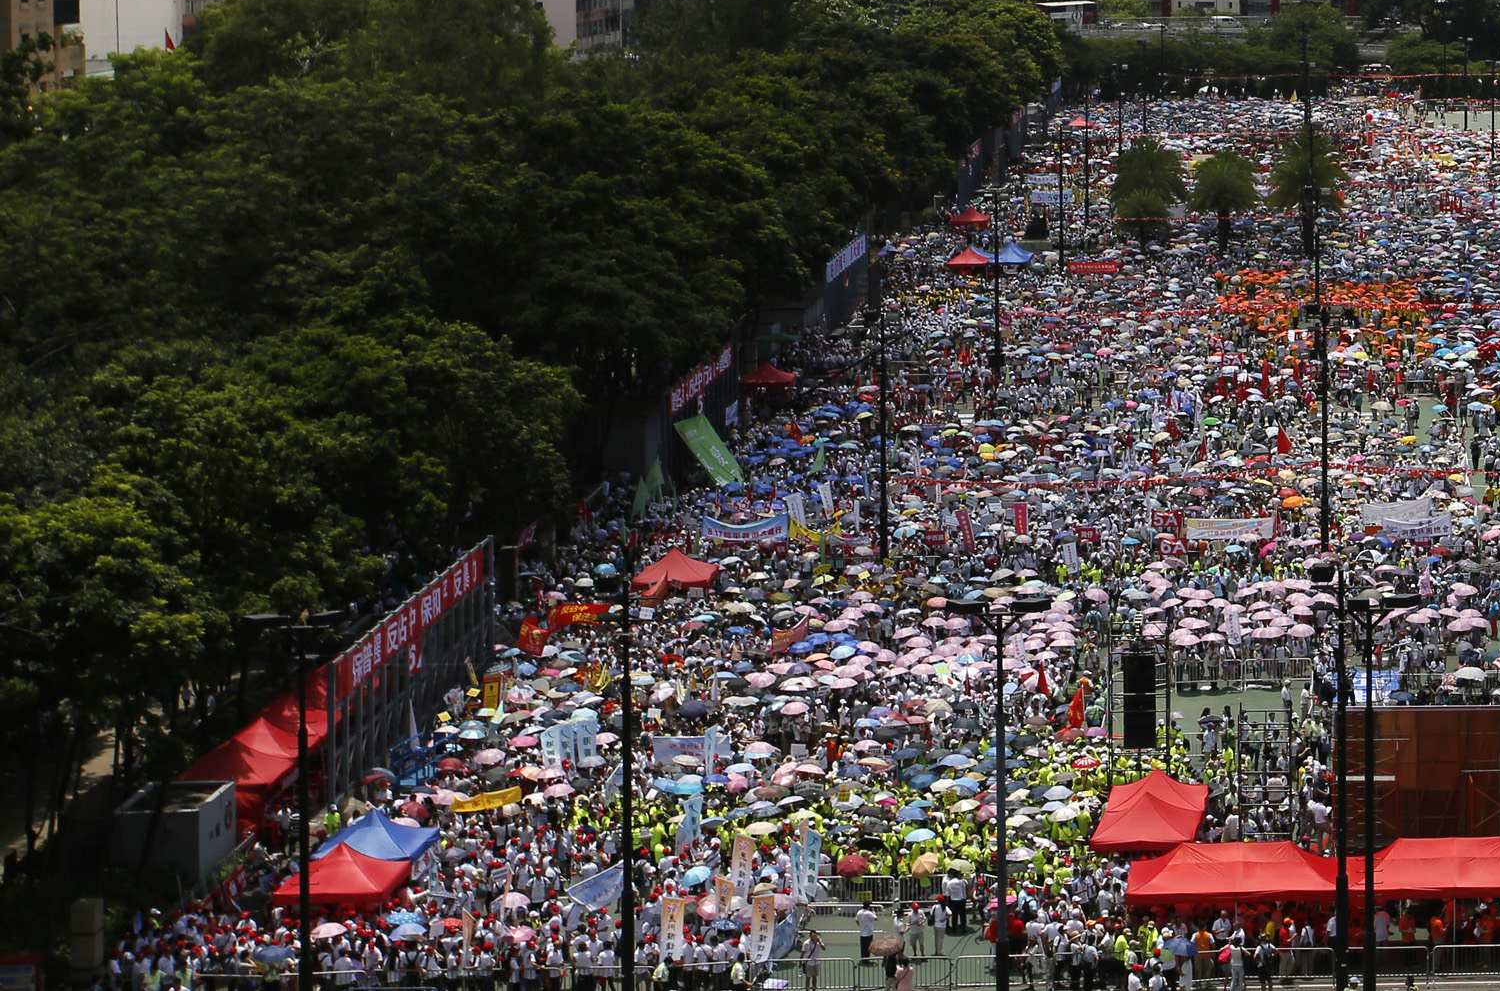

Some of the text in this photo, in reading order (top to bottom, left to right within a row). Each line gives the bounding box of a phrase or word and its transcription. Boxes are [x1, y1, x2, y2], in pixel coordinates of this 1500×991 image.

[1223, 357, 1242, 366] 5A
[1153, 512, 1178, 526] 5A
[1160, 540, 1187, 555] 6A
